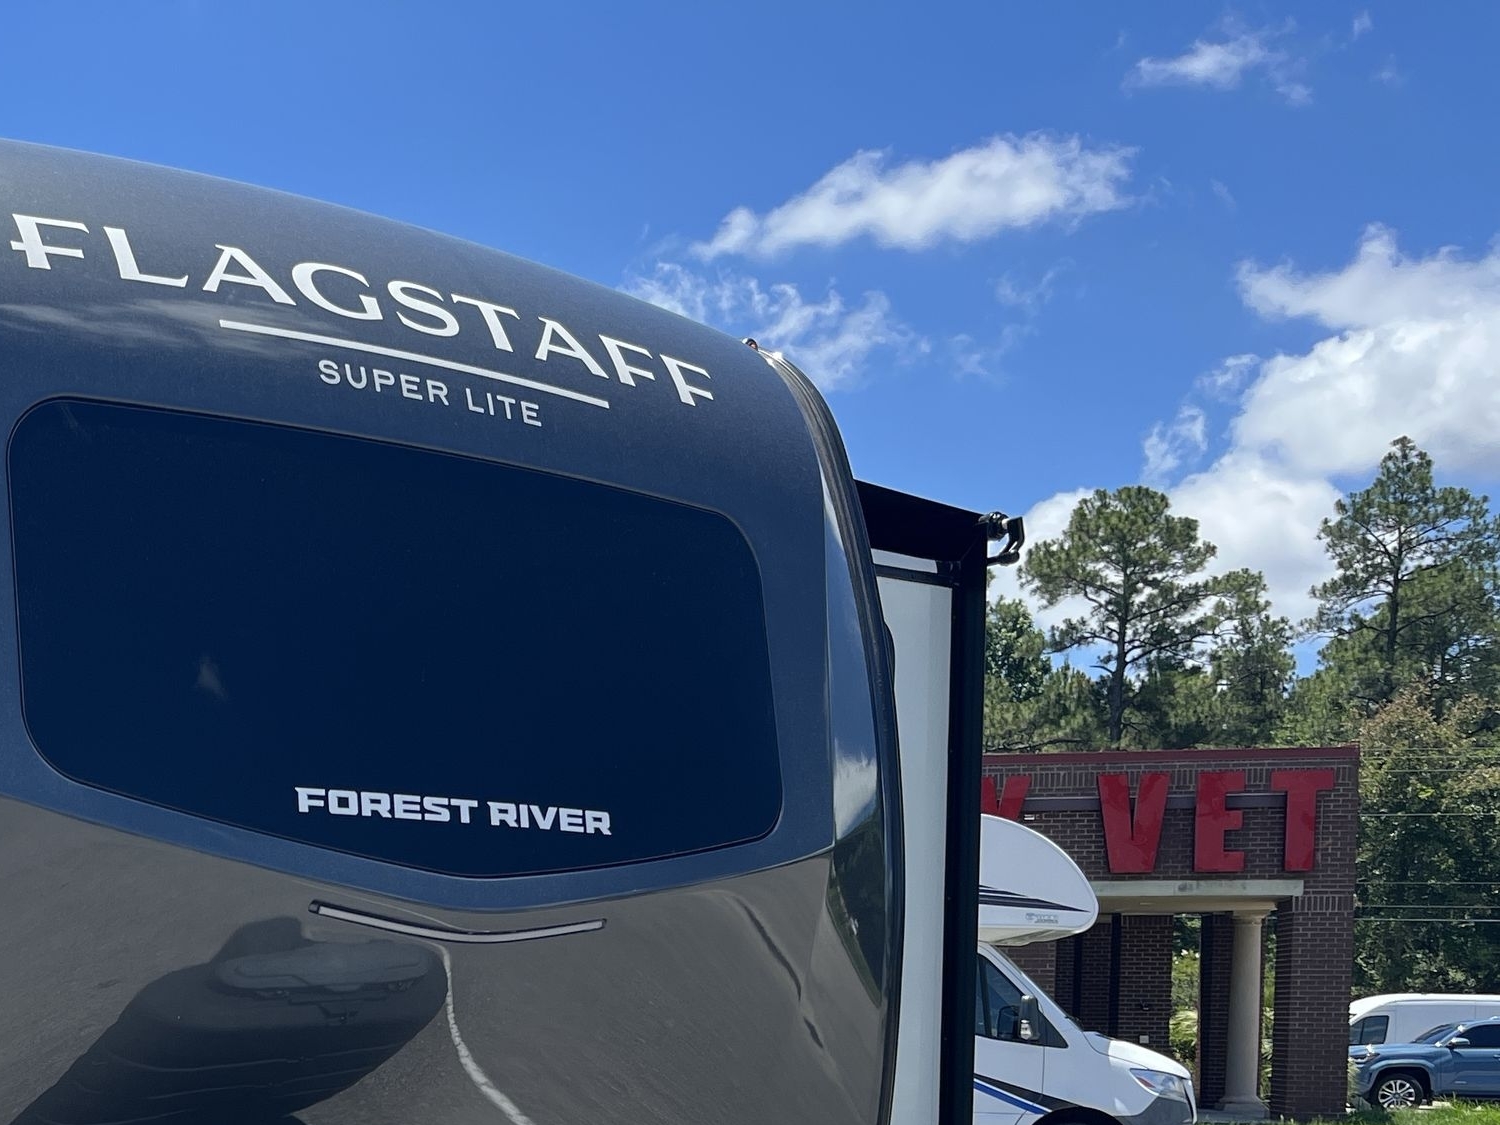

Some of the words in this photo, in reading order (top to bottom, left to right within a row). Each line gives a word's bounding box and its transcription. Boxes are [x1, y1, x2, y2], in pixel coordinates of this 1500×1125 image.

[10, 213, 714, 407] FLAGSTAFF
[318, 359, 449, 406] SUPER
[465, 386, 542, 427] LITE
[295, 786, 478, 824] FOREST
[487, 801, 612, 835] RIVER
[1097, 768, 1335, 873] VET
